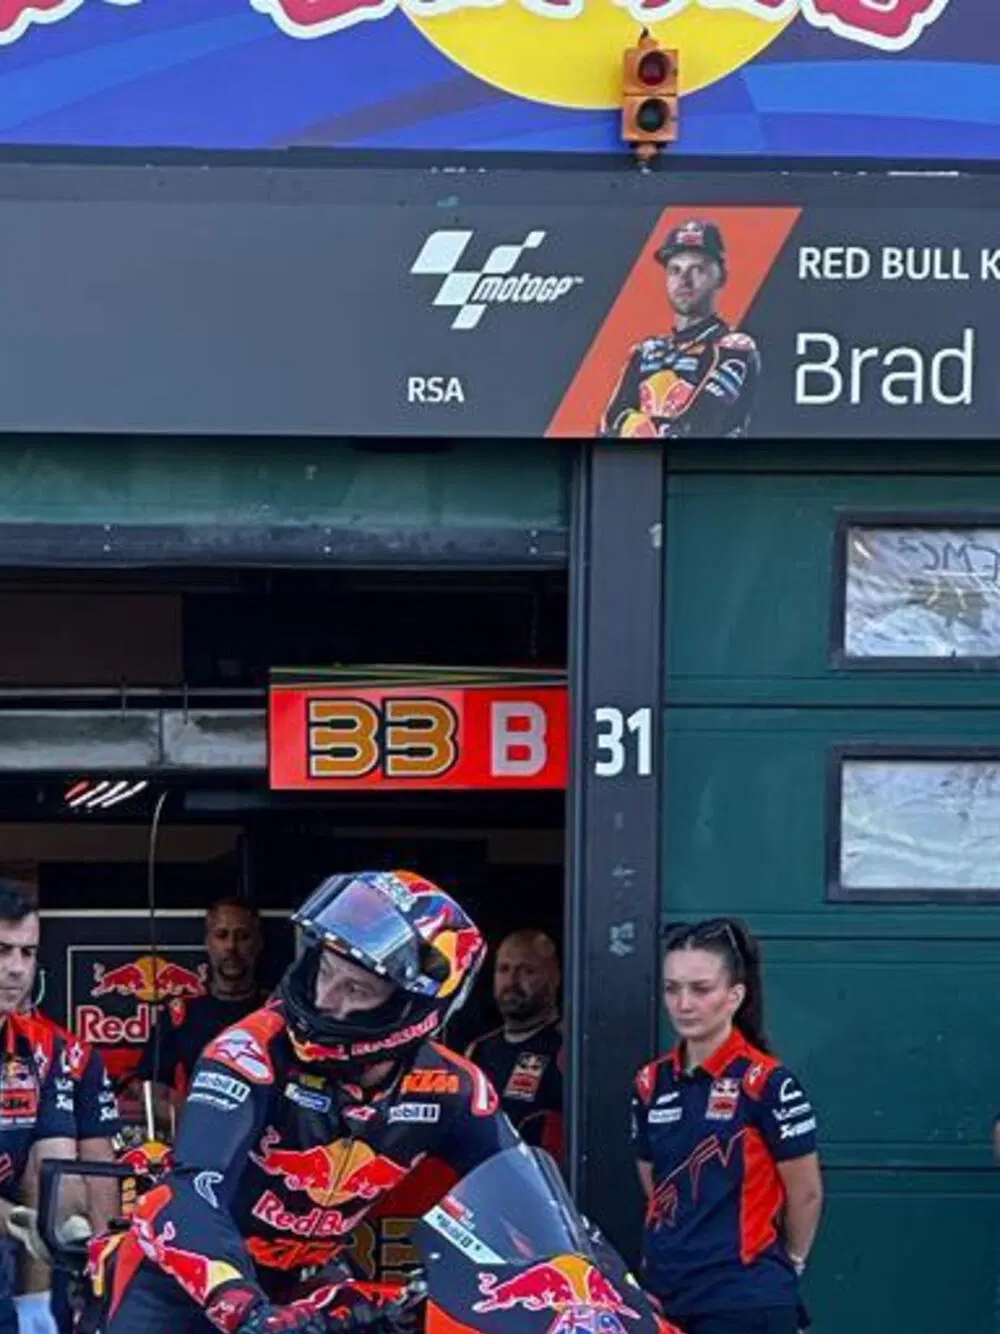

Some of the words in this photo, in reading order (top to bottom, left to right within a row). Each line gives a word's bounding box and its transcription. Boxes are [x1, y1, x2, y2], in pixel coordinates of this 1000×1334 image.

[798, 246, 871, 281] RED
[881, 246, 970, 281] BULL
[795, 327, 975, 406] Brad
[407, 376, 466, 404] RSA
[594, 707, 653, 777] 31
[76, 1003, 150, 1043] Red
[252, 1189, 323, 1238] Red
